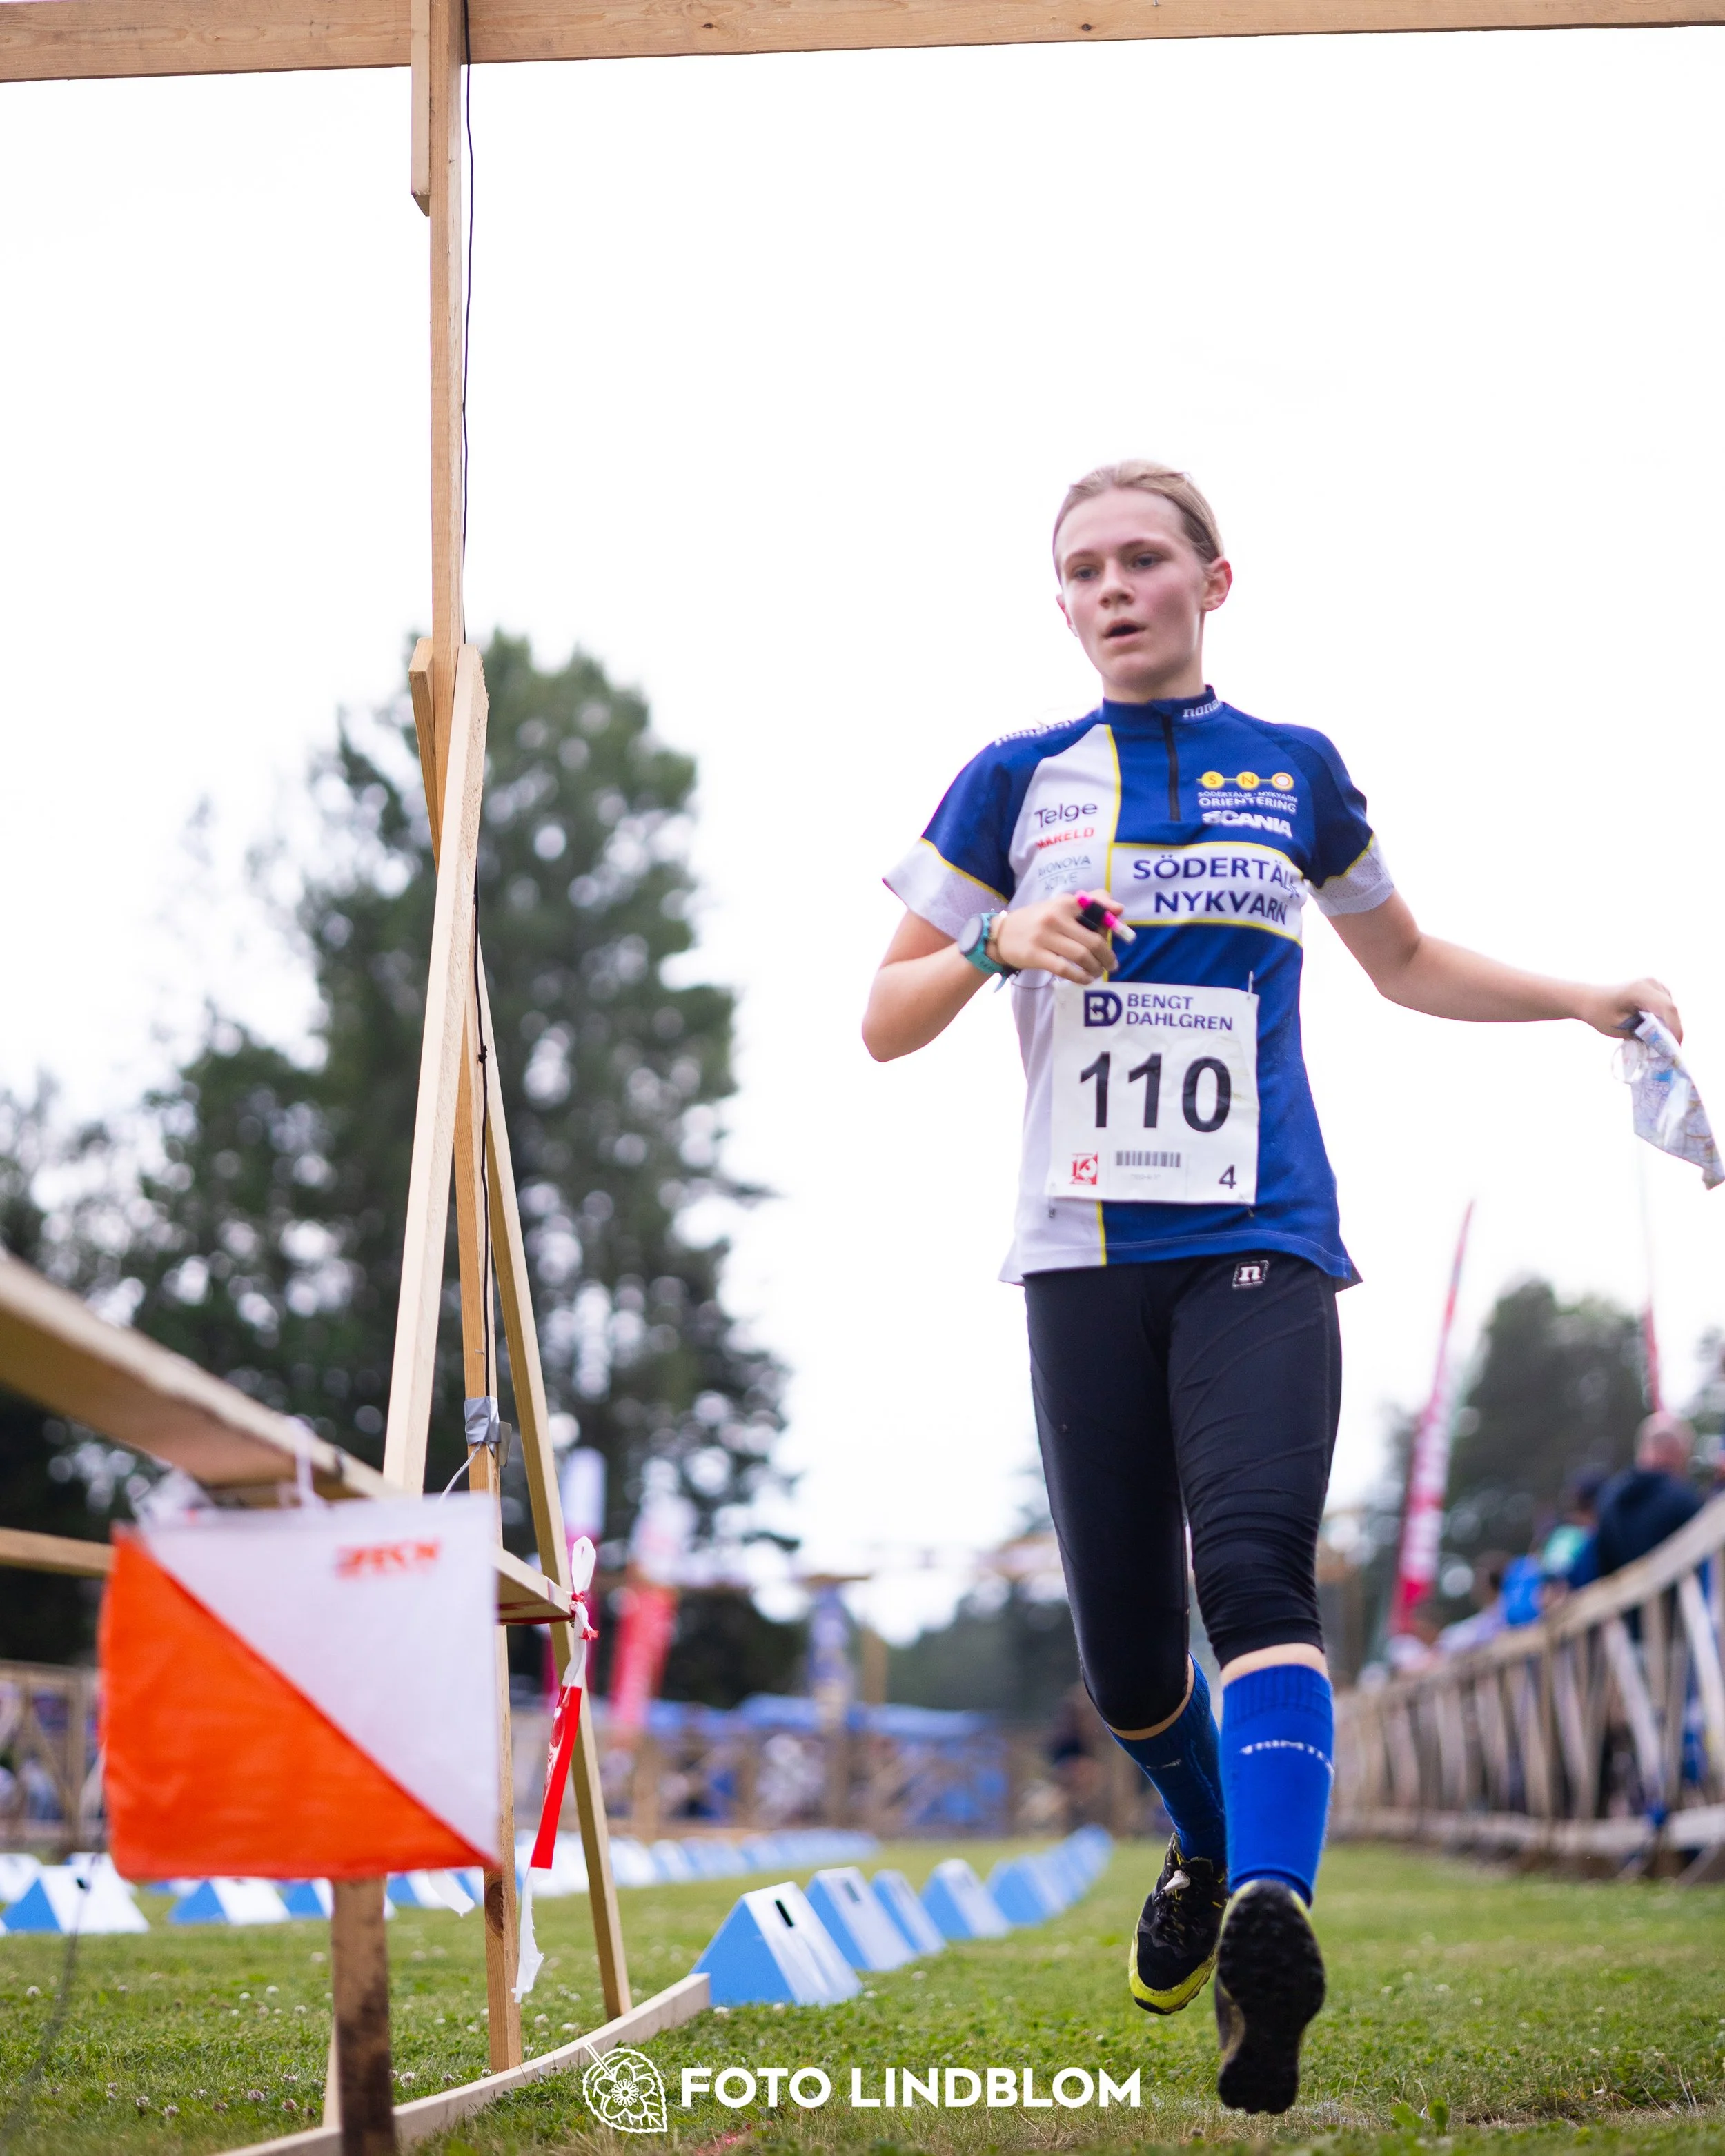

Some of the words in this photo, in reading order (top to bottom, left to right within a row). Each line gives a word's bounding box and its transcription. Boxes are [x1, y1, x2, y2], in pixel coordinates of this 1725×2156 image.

[1035, 803, 1098, 827] Telge
[1199, 797, 1297, 813] ORIENTERING
[1202, 810, 1292, 838] SCANIA
[1154, 890, 1288, 924] NYKVARN
[1127, 993, 1193, 1009] BENGT
[1127, 1011, 1232, 1030] DAHLGREN
[1080, 1051, 1232, 1132] 110
[1219, 1164, 1236, 1189] 4
